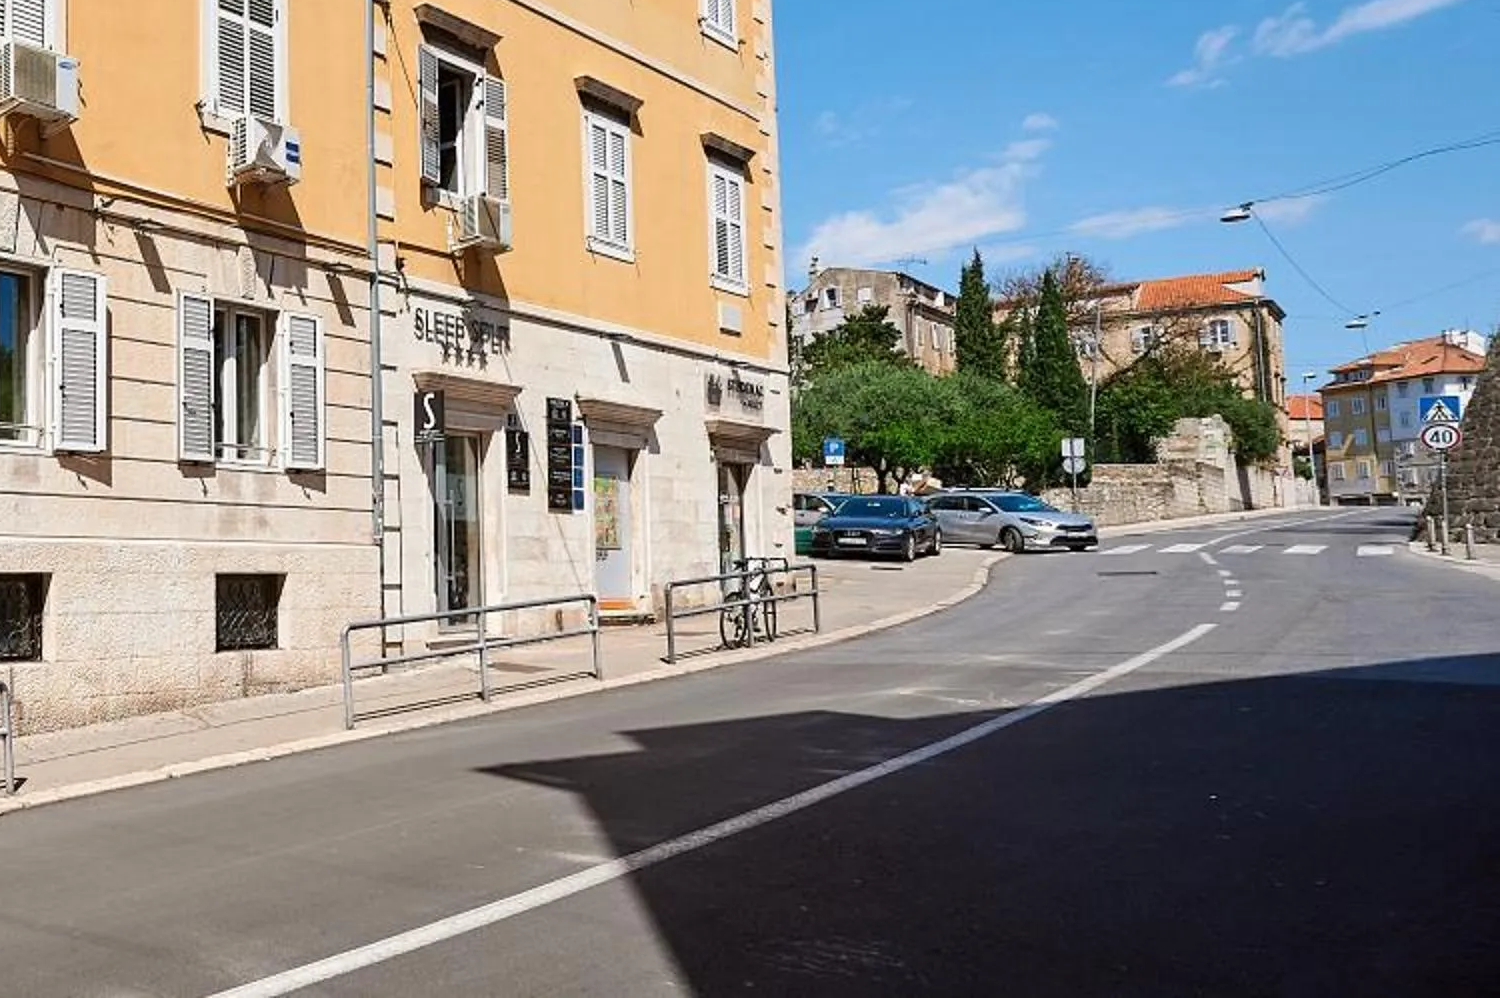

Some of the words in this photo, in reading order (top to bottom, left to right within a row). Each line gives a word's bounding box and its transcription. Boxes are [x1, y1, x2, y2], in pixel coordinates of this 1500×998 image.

[414, 307, 466, 345] SLEEP
[423, 393, 435, 429] S
[1430, 429, 1453, 443] 40
